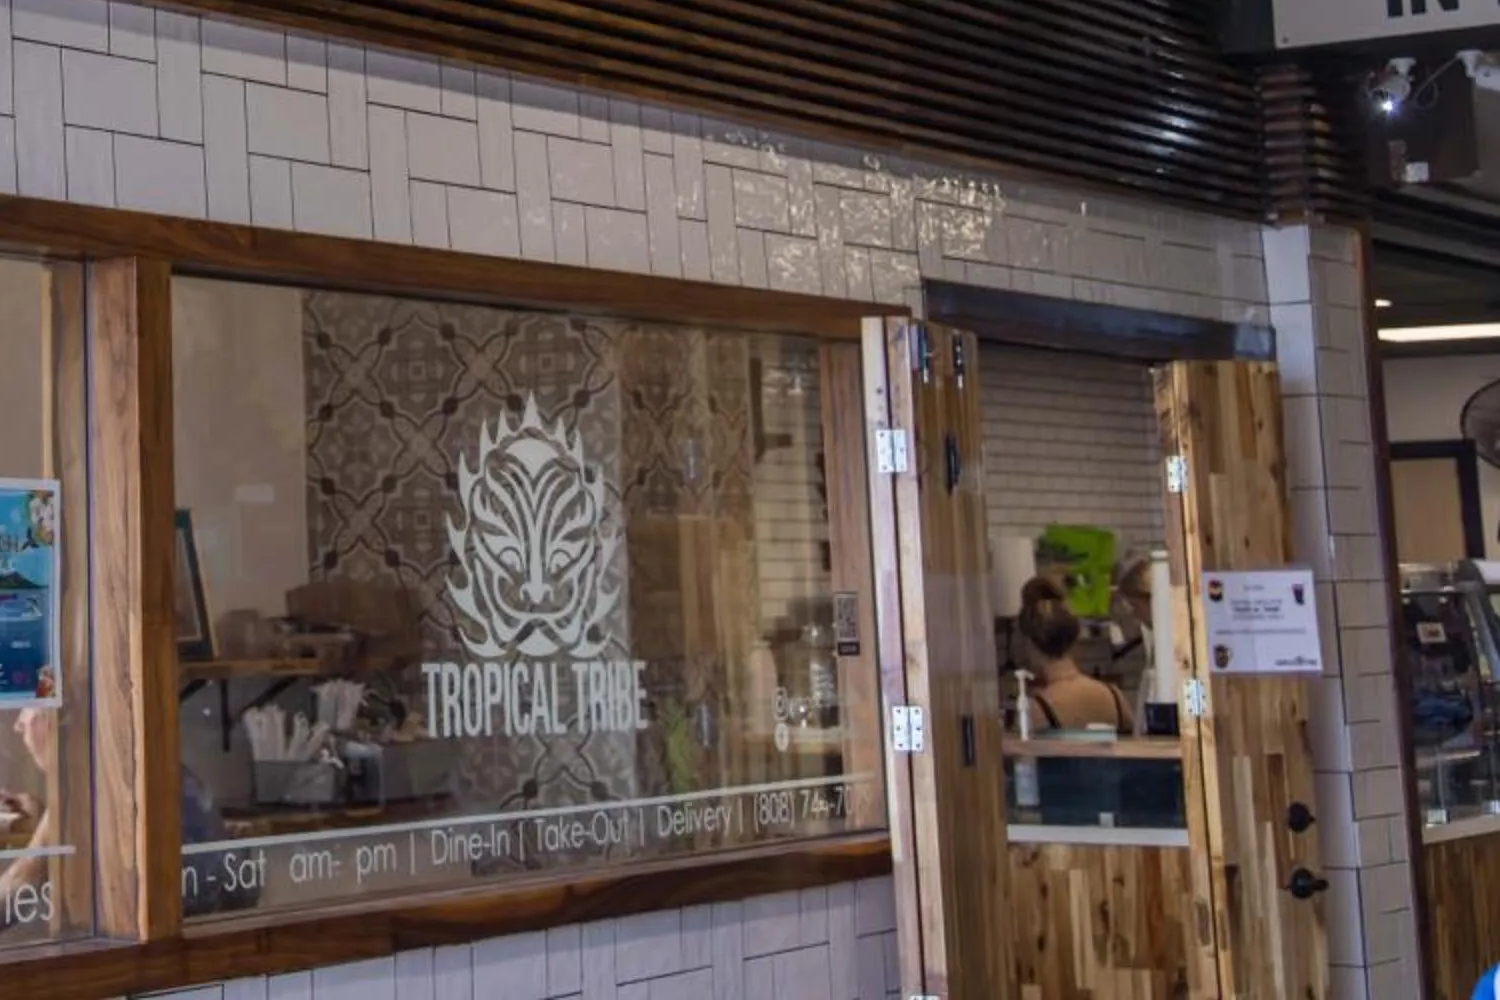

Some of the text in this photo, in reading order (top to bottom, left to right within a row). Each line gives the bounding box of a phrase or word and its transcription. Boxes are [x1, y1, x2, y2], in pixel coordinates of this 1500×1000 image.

[422, 661, 648, 738] TROPICAL TRIBE
[356, 842, 396, 888] pm
[431, 824, 510, 865] Dine-In
[536, 811, 630, 851] Take-Out
[657, 802, 732, 837] Delivery
[753, 793, 796, 832] (808)
